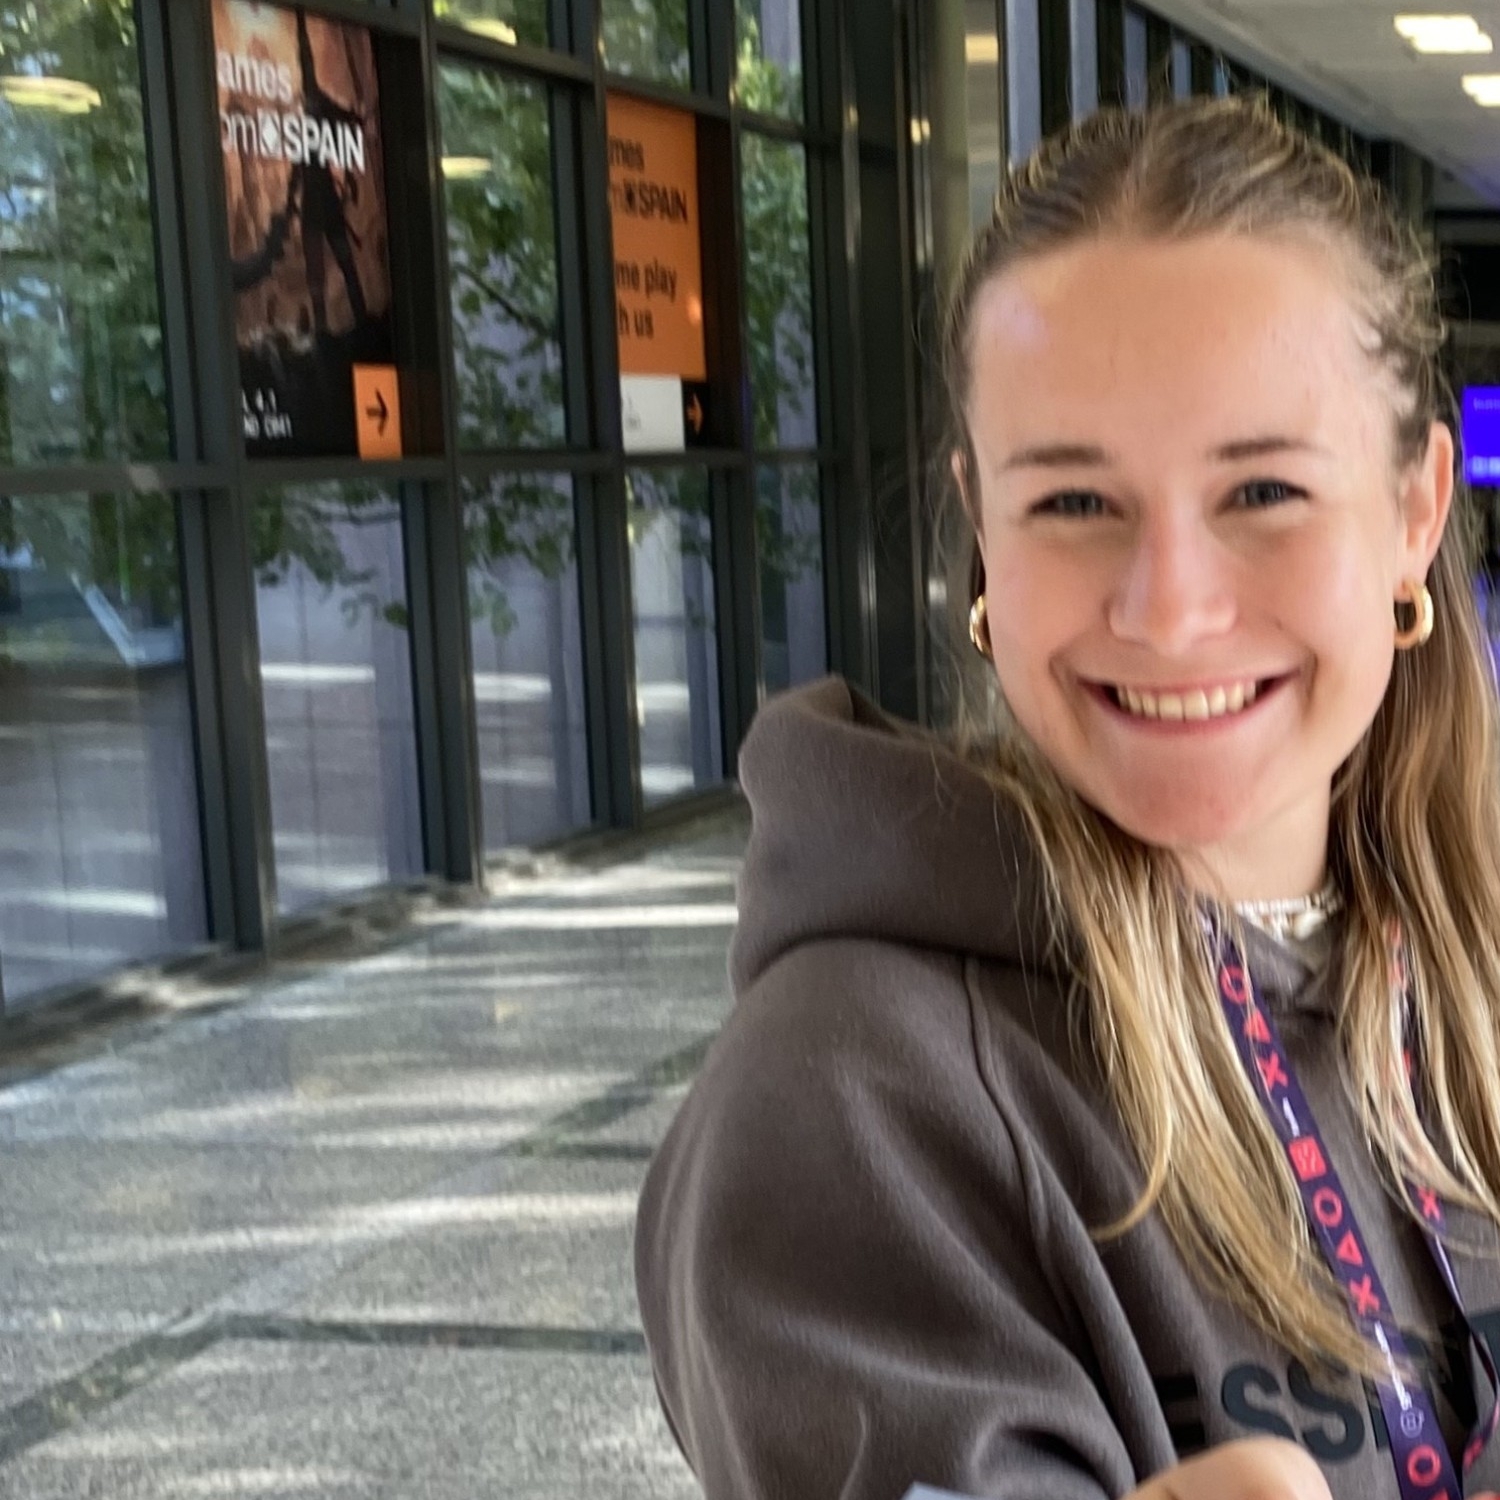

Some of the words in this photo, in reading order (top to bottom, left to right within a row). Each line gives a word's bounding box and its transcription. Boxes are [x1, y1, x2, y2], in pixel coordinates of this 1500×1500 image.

[283, 111, 366, 175] SPAIN
[639, 182, 689, 224] SPAIN
[644, 257, 677, 303] play
[633, 309, 654, 339] us
